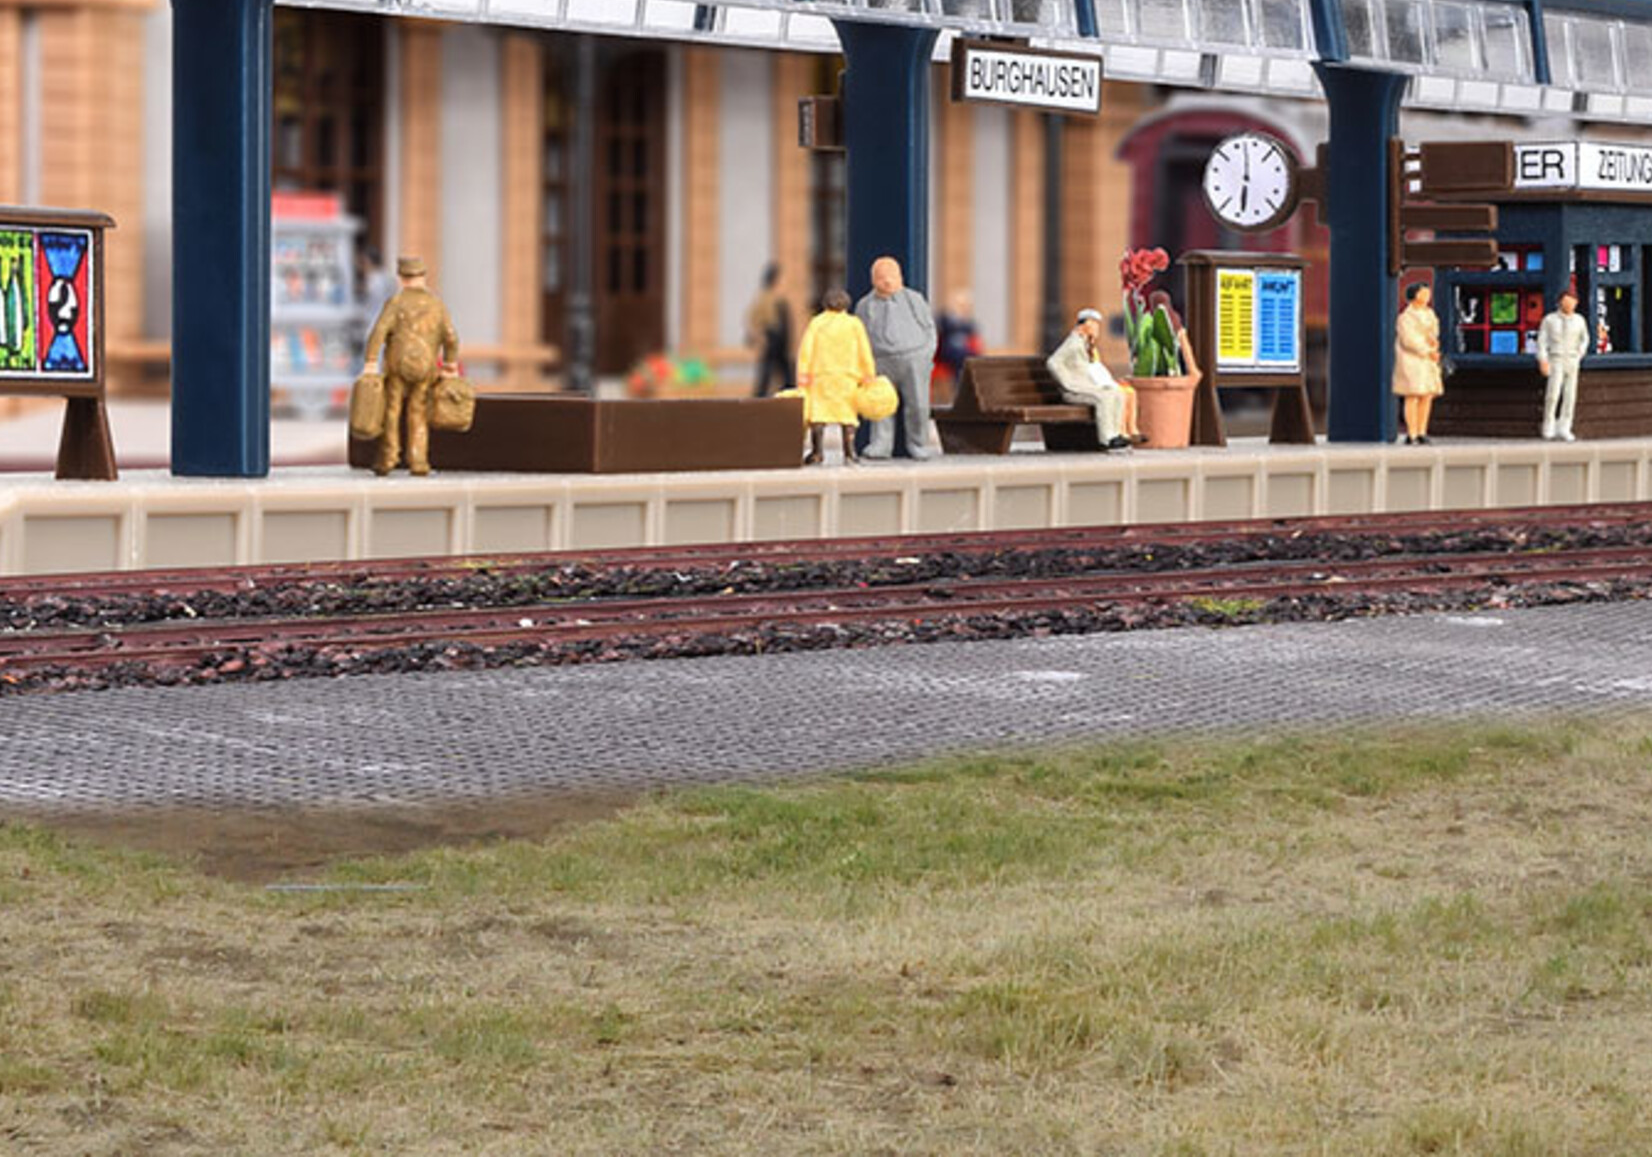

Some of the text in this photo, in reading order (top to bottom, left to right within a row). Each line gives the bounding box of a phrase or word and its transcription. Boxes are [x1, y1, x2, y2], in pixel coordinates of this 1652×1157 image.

[970, 56, 1095, 99] BURGHAUSEN
[1515, 149, 1565, 180] ER
[1597, 149, 1652, 184] ZEITUNG
